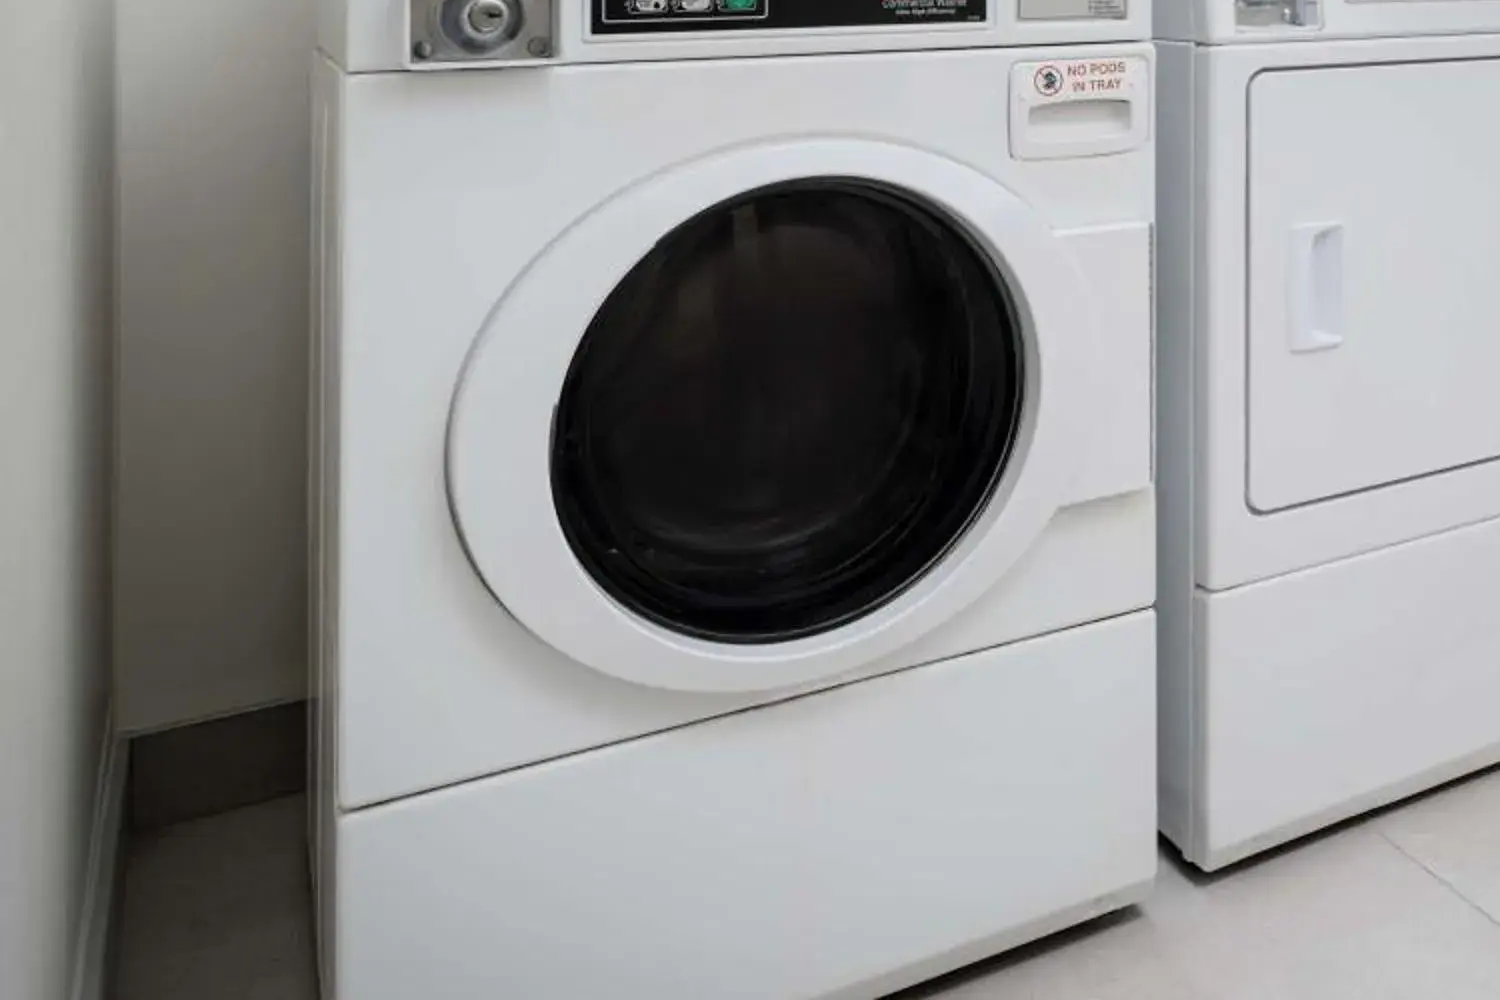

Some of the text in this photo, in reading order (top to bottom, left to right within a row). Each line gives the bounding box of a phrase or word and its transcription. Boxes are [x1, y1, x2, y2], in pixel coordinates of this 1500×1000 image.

[1067, 61, 1126, 77] NO PODS
[1071, 79, 1122, 92] IN TRAY
